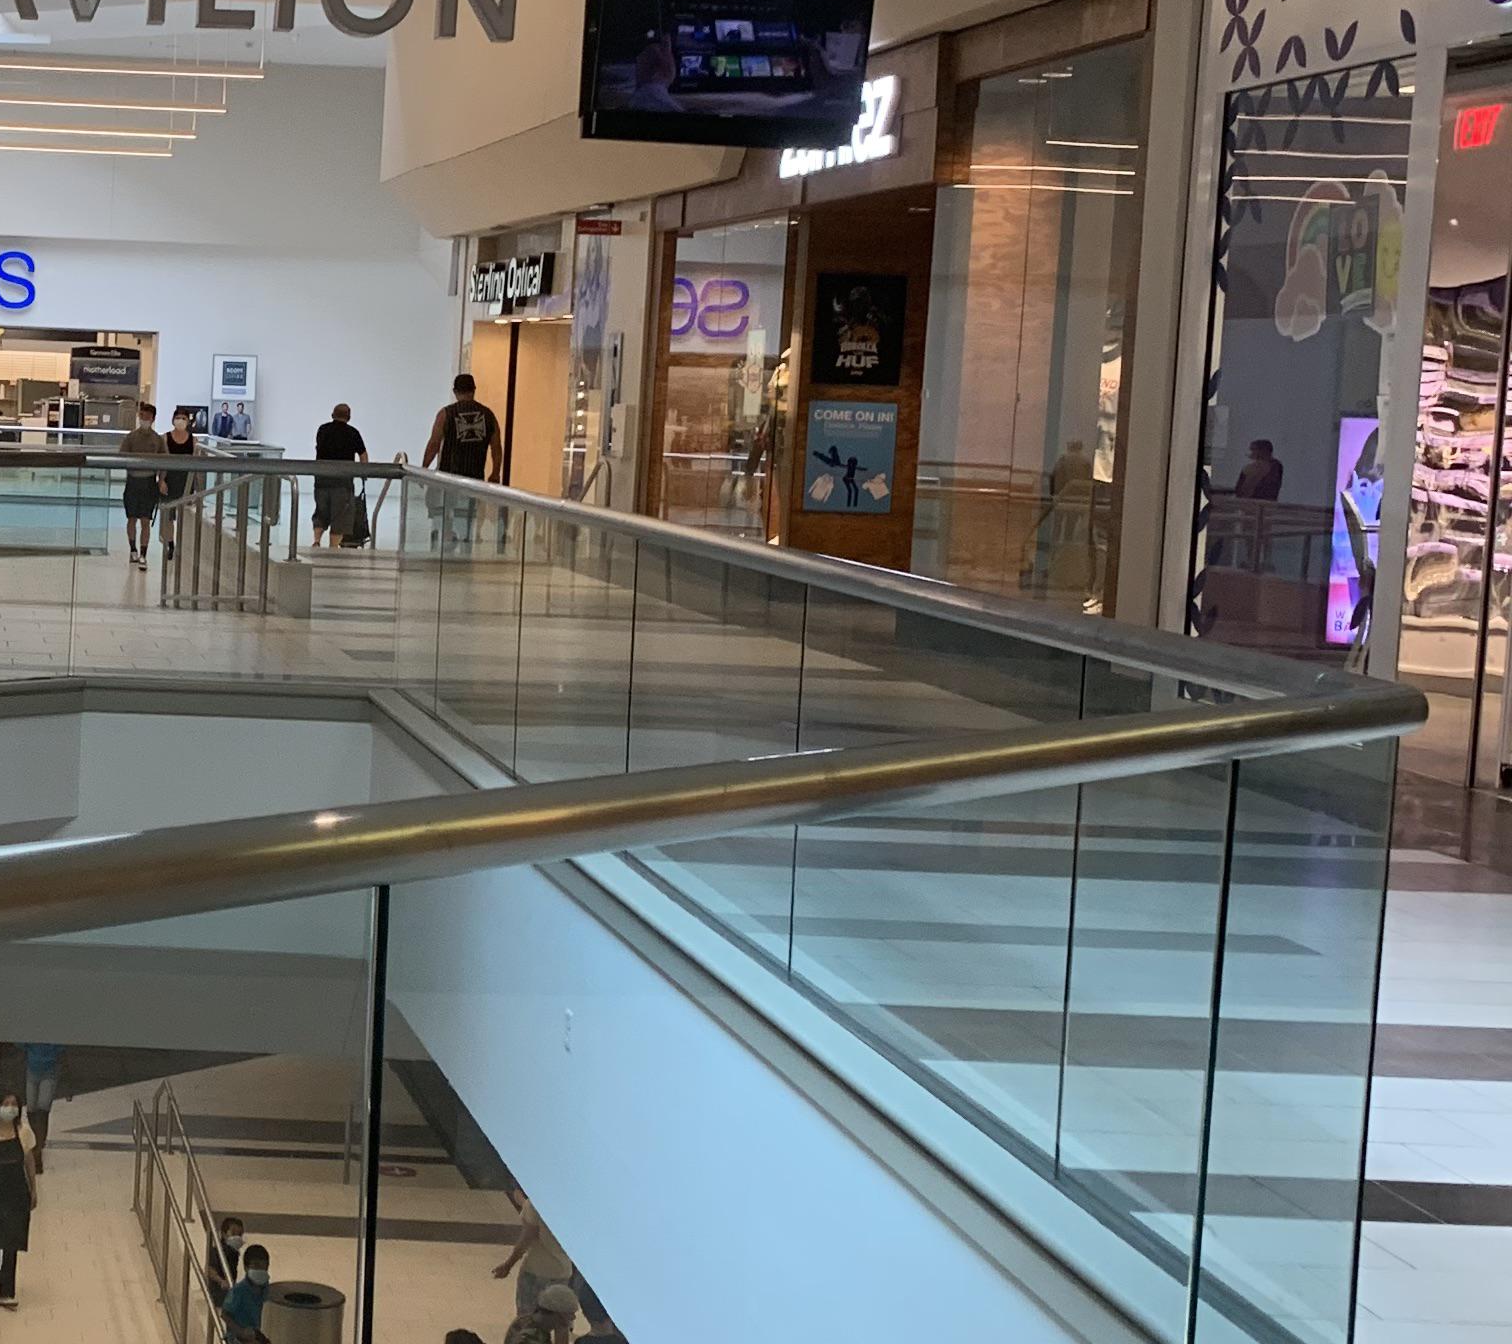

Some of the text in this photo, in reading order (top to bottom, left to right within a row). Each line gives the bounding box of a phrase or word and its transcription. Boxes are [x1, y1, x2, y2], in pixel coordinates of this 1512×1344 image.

[470, 252, 544, 315] Sterling Optical
[835, 355, 880, 369] HUF
[814, 409, 894, 423] COME ON IN!
